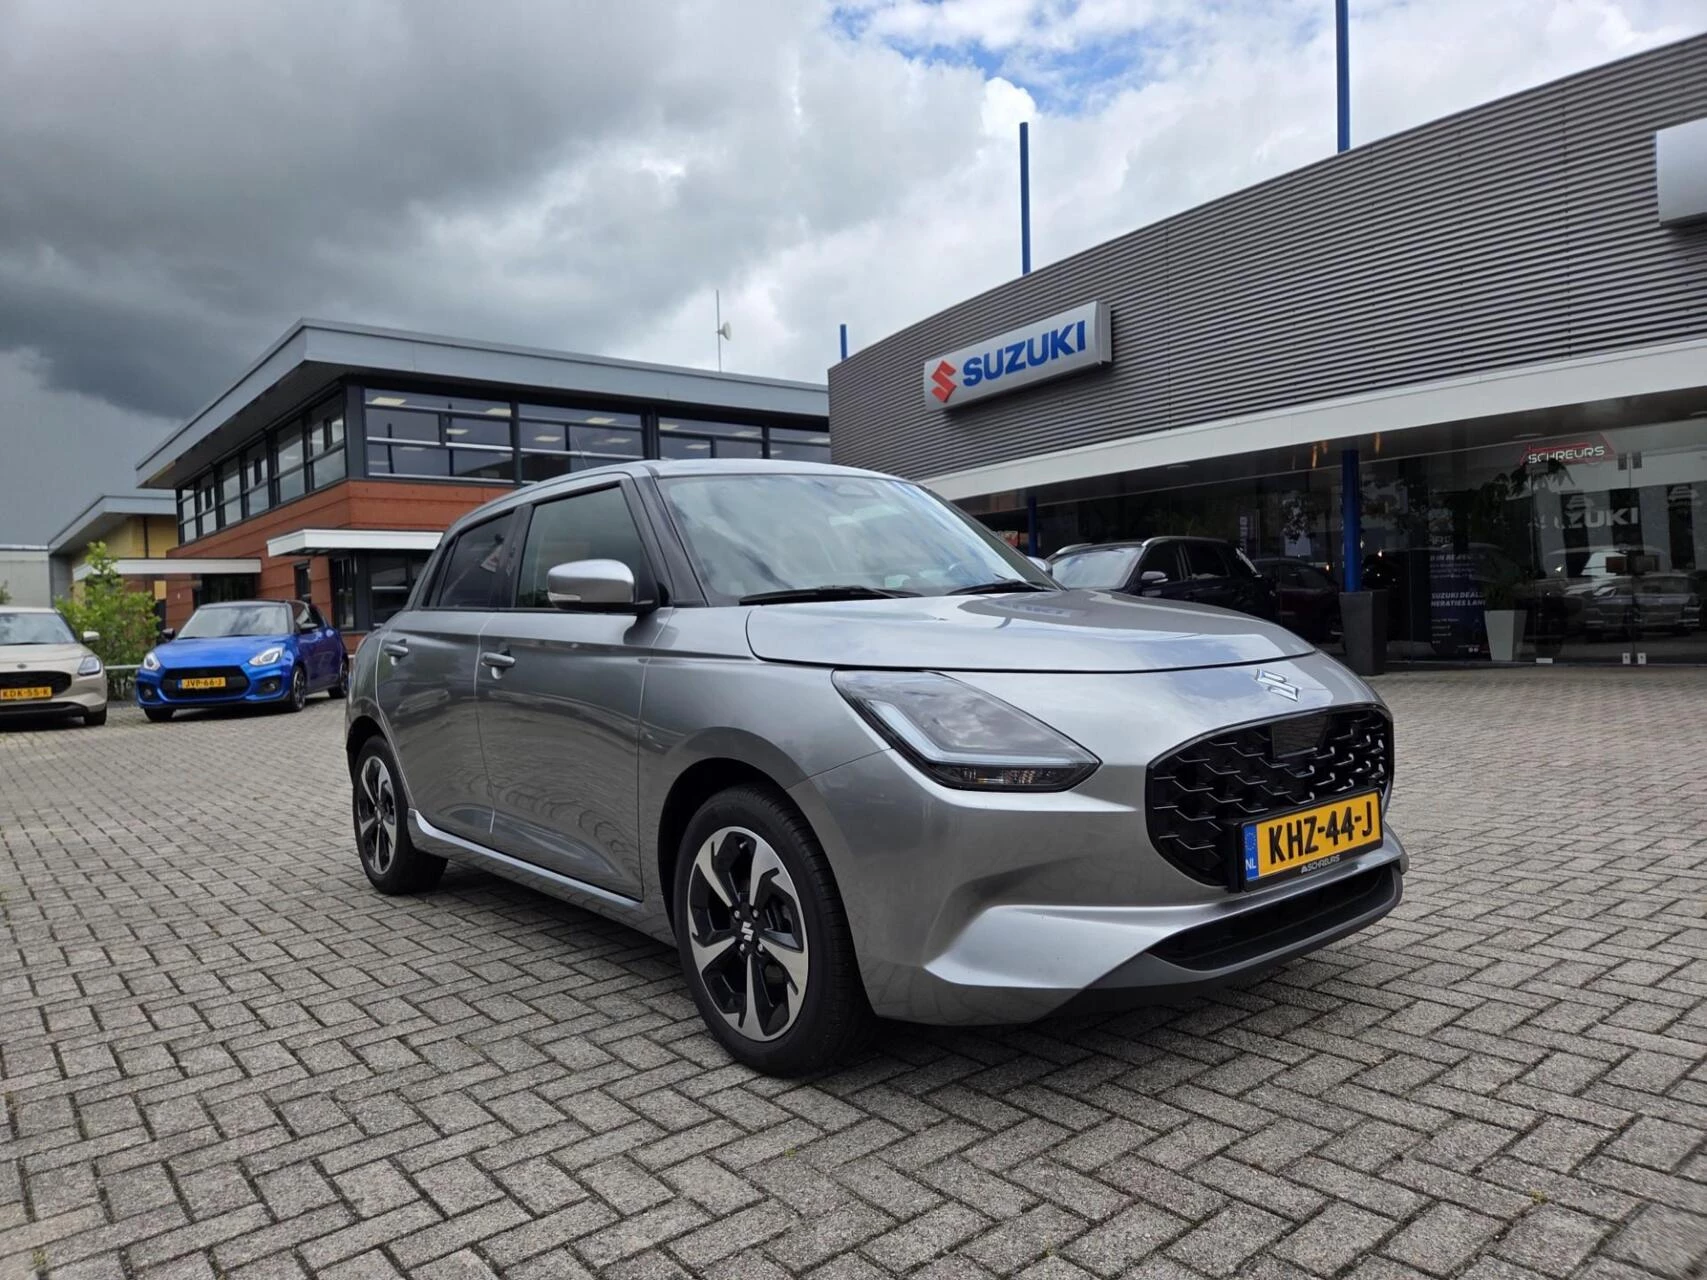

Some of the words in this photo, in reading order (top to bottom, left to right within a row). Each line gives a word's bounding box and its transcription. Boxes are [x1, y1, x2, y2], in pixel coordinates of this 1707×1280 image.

[963, 320, 1086, 387] SUZUKI
[1528, 446, 1605, 464] SCHREURS
[1268, 801, 1373, 865] KHZ-44-J
[1245, 858, 1257, 871] NL
